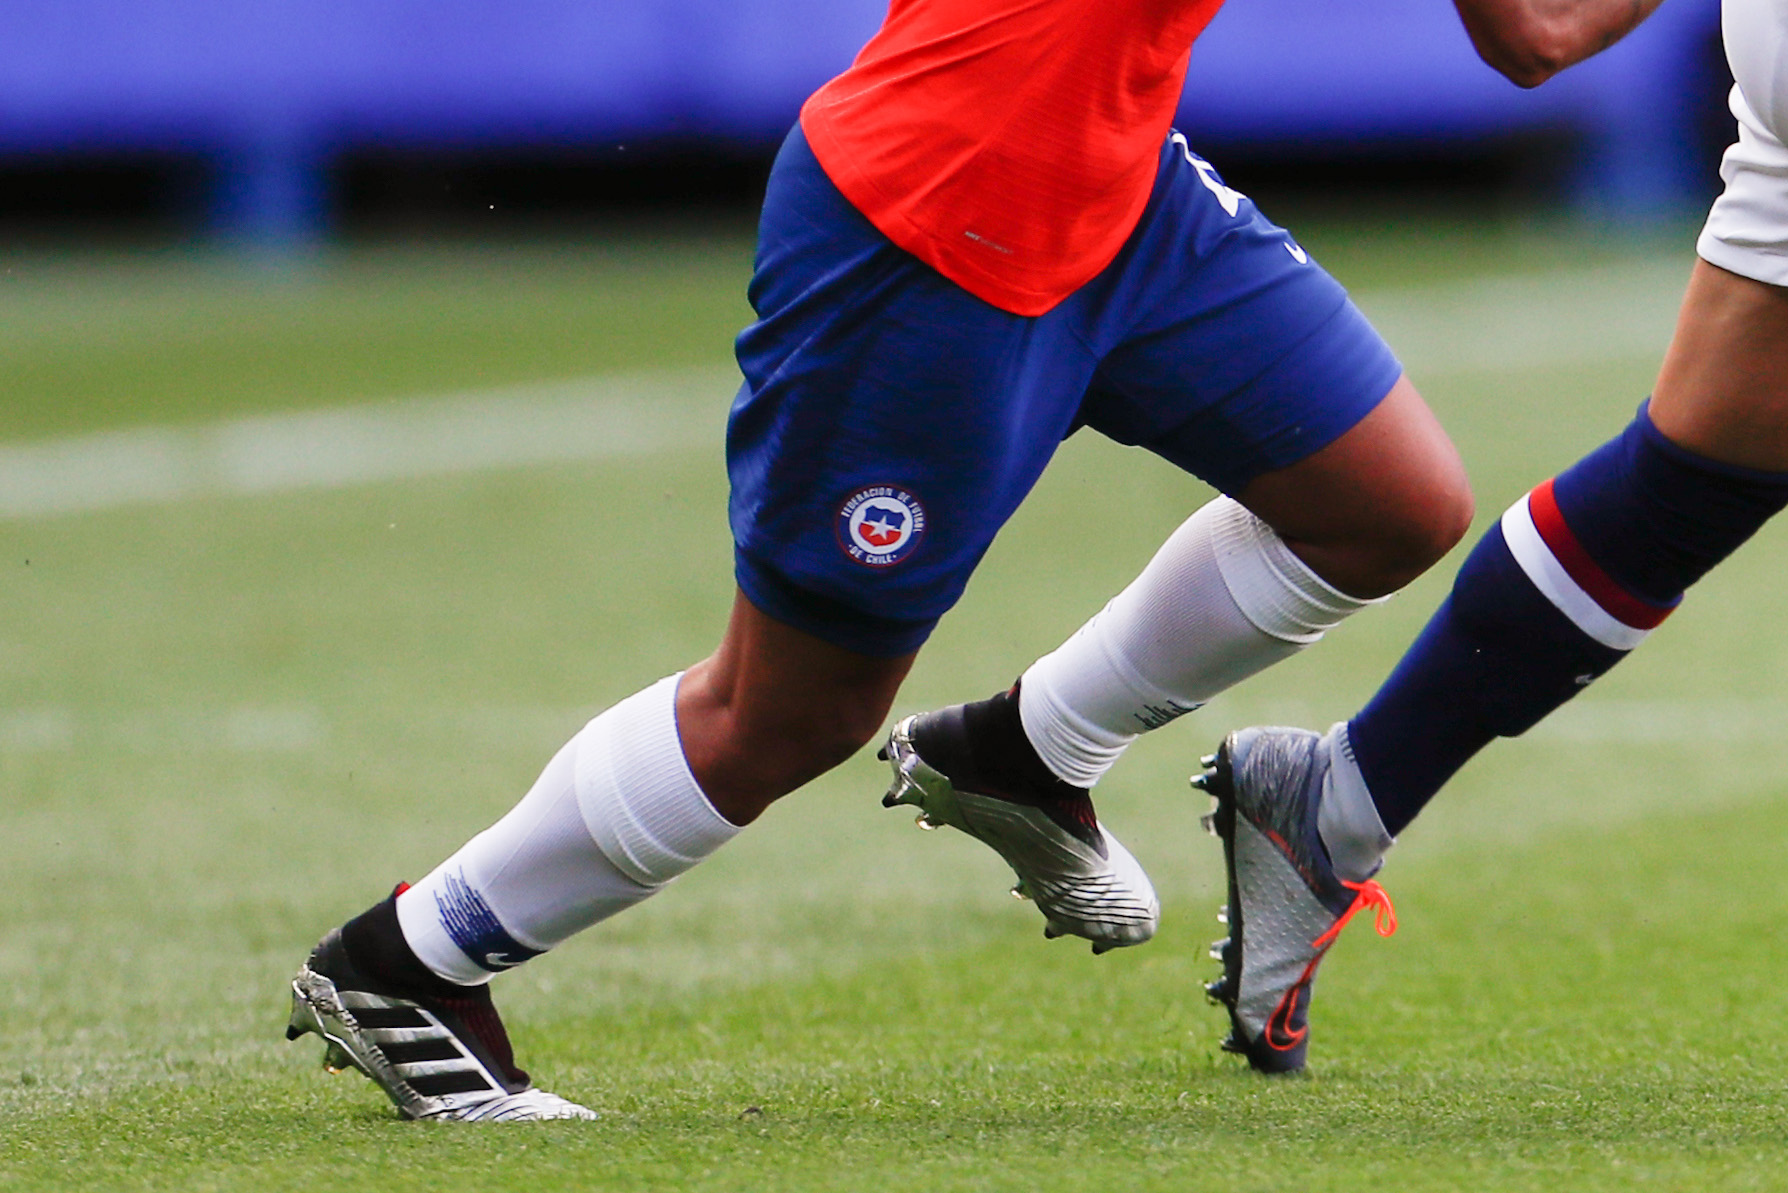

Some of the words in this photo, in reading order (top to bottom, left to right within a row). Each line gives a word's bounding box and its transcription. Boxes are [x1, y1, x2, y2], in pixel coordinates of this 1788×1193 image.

[897, 492, 911, 502] DE
[849, 547, 864, 559] DE
[866, 554, 892, 565] CHILE
